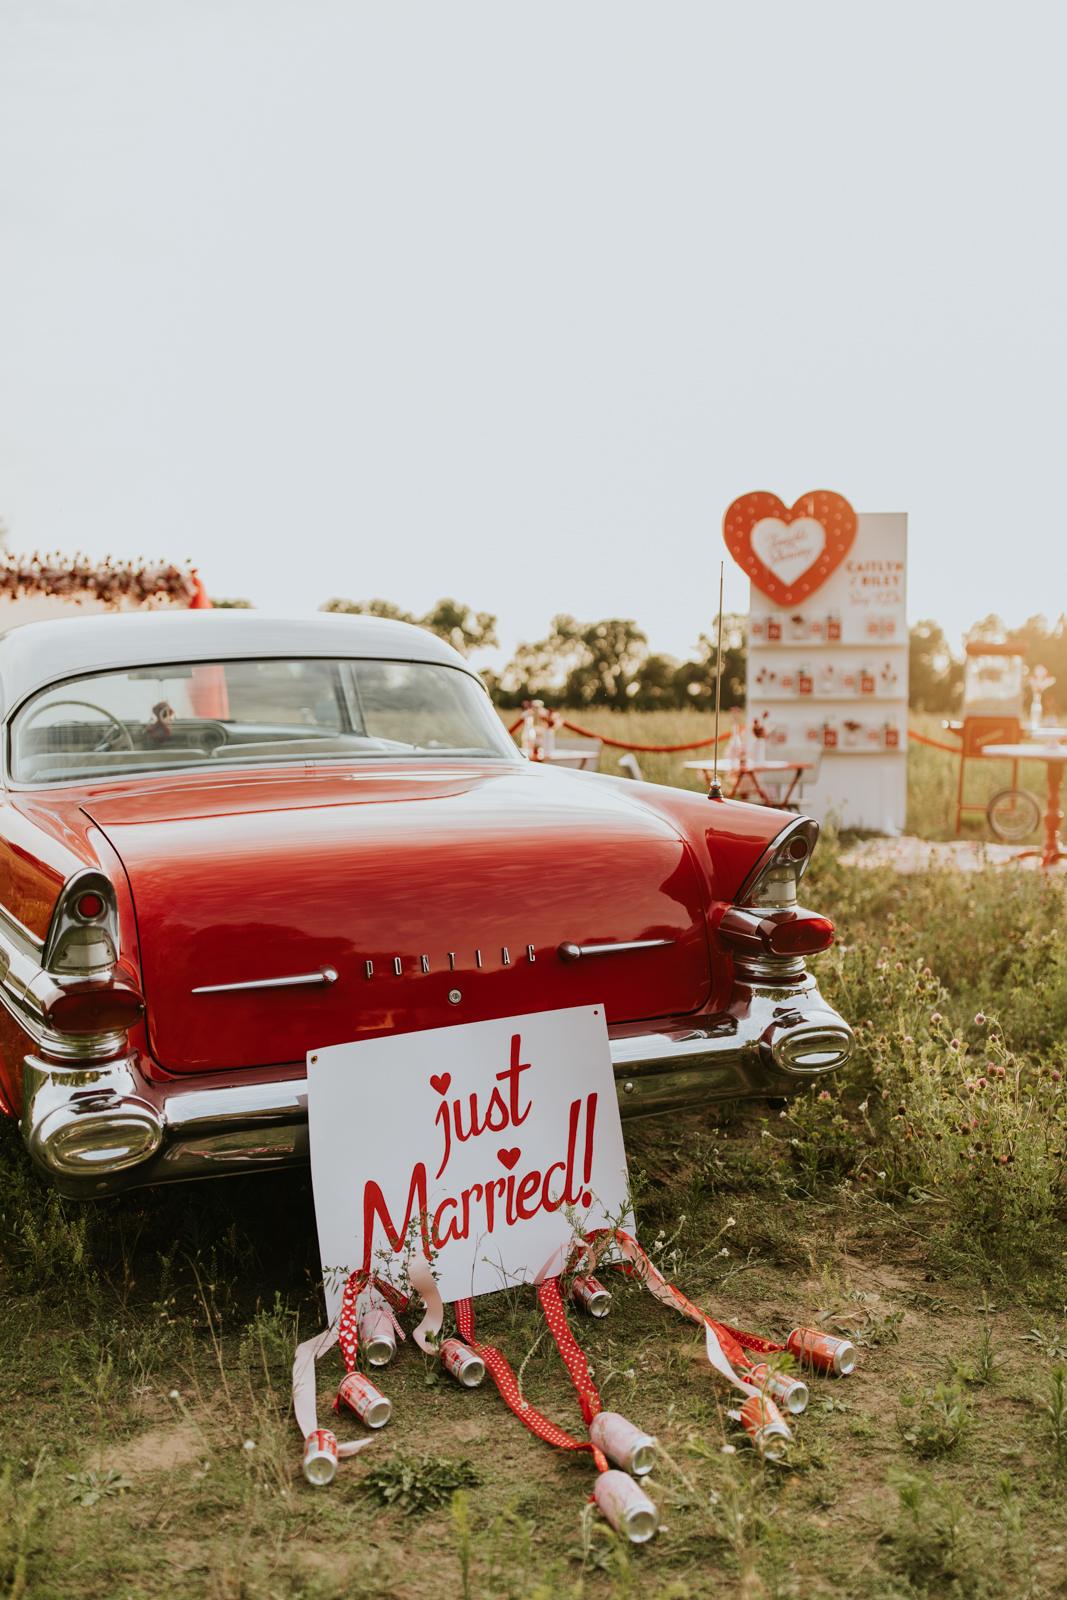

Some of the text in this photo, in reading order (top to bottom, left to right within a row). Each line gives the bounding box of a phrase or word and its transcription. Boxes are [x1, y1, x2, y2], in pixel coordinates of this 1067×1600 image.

[365, 944, 536, 979] PONTIAC
[430, 1033, 533, 1180] just
[362, 1092, 599, 1274] Married!
